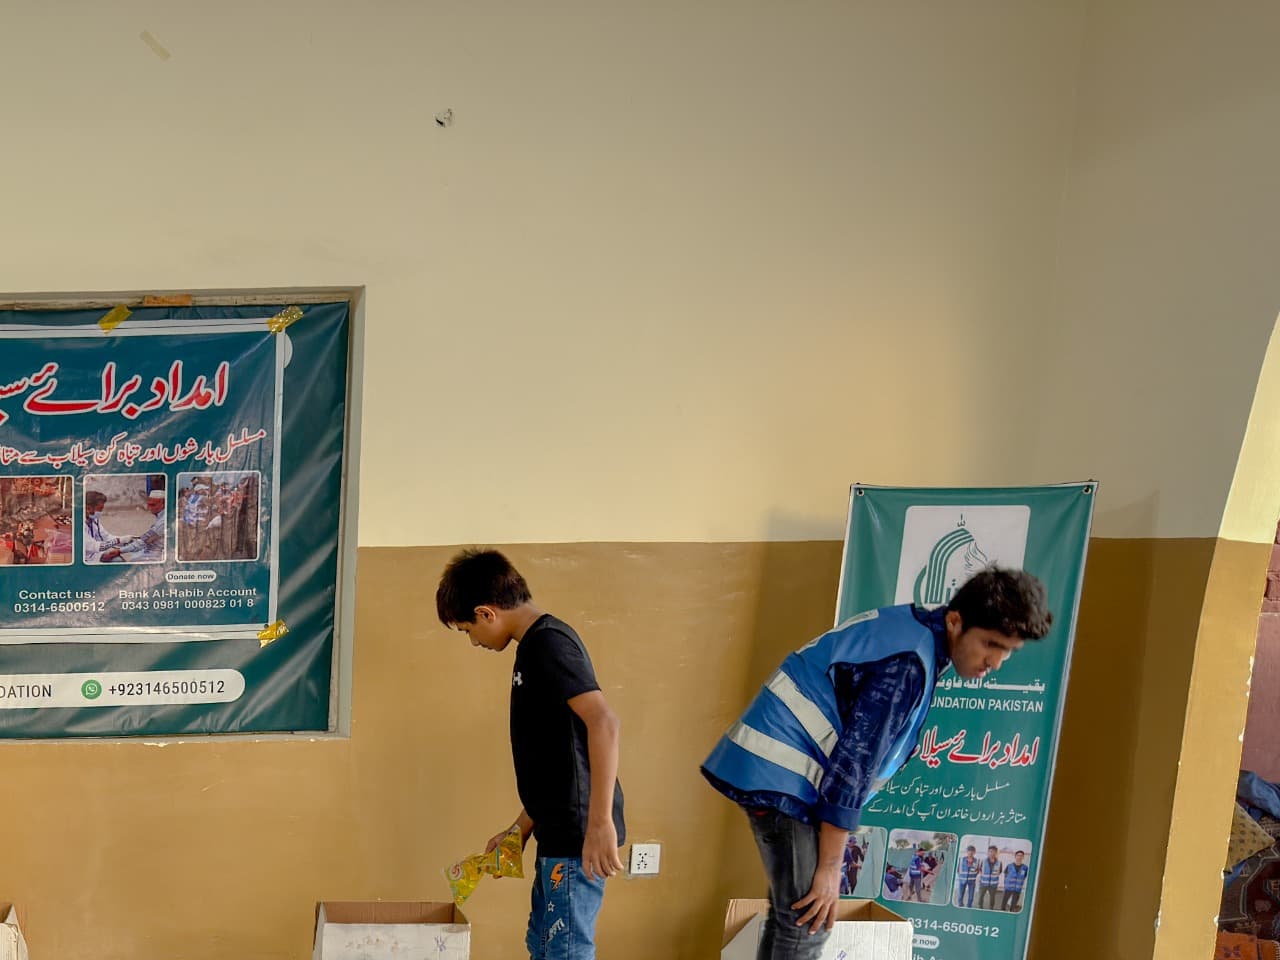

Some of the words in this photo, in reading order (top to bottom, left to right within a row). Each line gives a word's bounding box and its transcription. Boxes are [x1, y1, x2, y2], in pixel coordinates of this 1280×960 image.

[142, 359, 229, 410] امداد
[140, 443, 162, 462] اور
[216, 428, 266, 462] مسلسل
[19, 448, 48, 465] سے
[47, 443, 95, 468] سیلاب
[167, 573, 194, 581] Donate
[19, 590, 72, 600] Contact
[75, 591, 96, 600] us:
[119, 590, 150, 600] Bank
[152, 588, 204, 599] Al-Habib
[207, 587, 257, 598] Account
[14, 602, 105, 613] 0314-6500512
[121, 601, 150, 611] 0343
[153, 600, 181, 610] 0981
[184, 599, 227, 610] 000823
[229, 598, 243, 608] 01
[246, 598, 255, 608] 8
[108, 680, 226, 697] +923146500512
[988, 699, 1044, 713] PAKISTAN
[929, 785, 943, 796] اور
[906, 799, 920, 817] کی
[917, 804, 938, 822] آپ
[908, 917, 1000, 938] 0314-6500512
